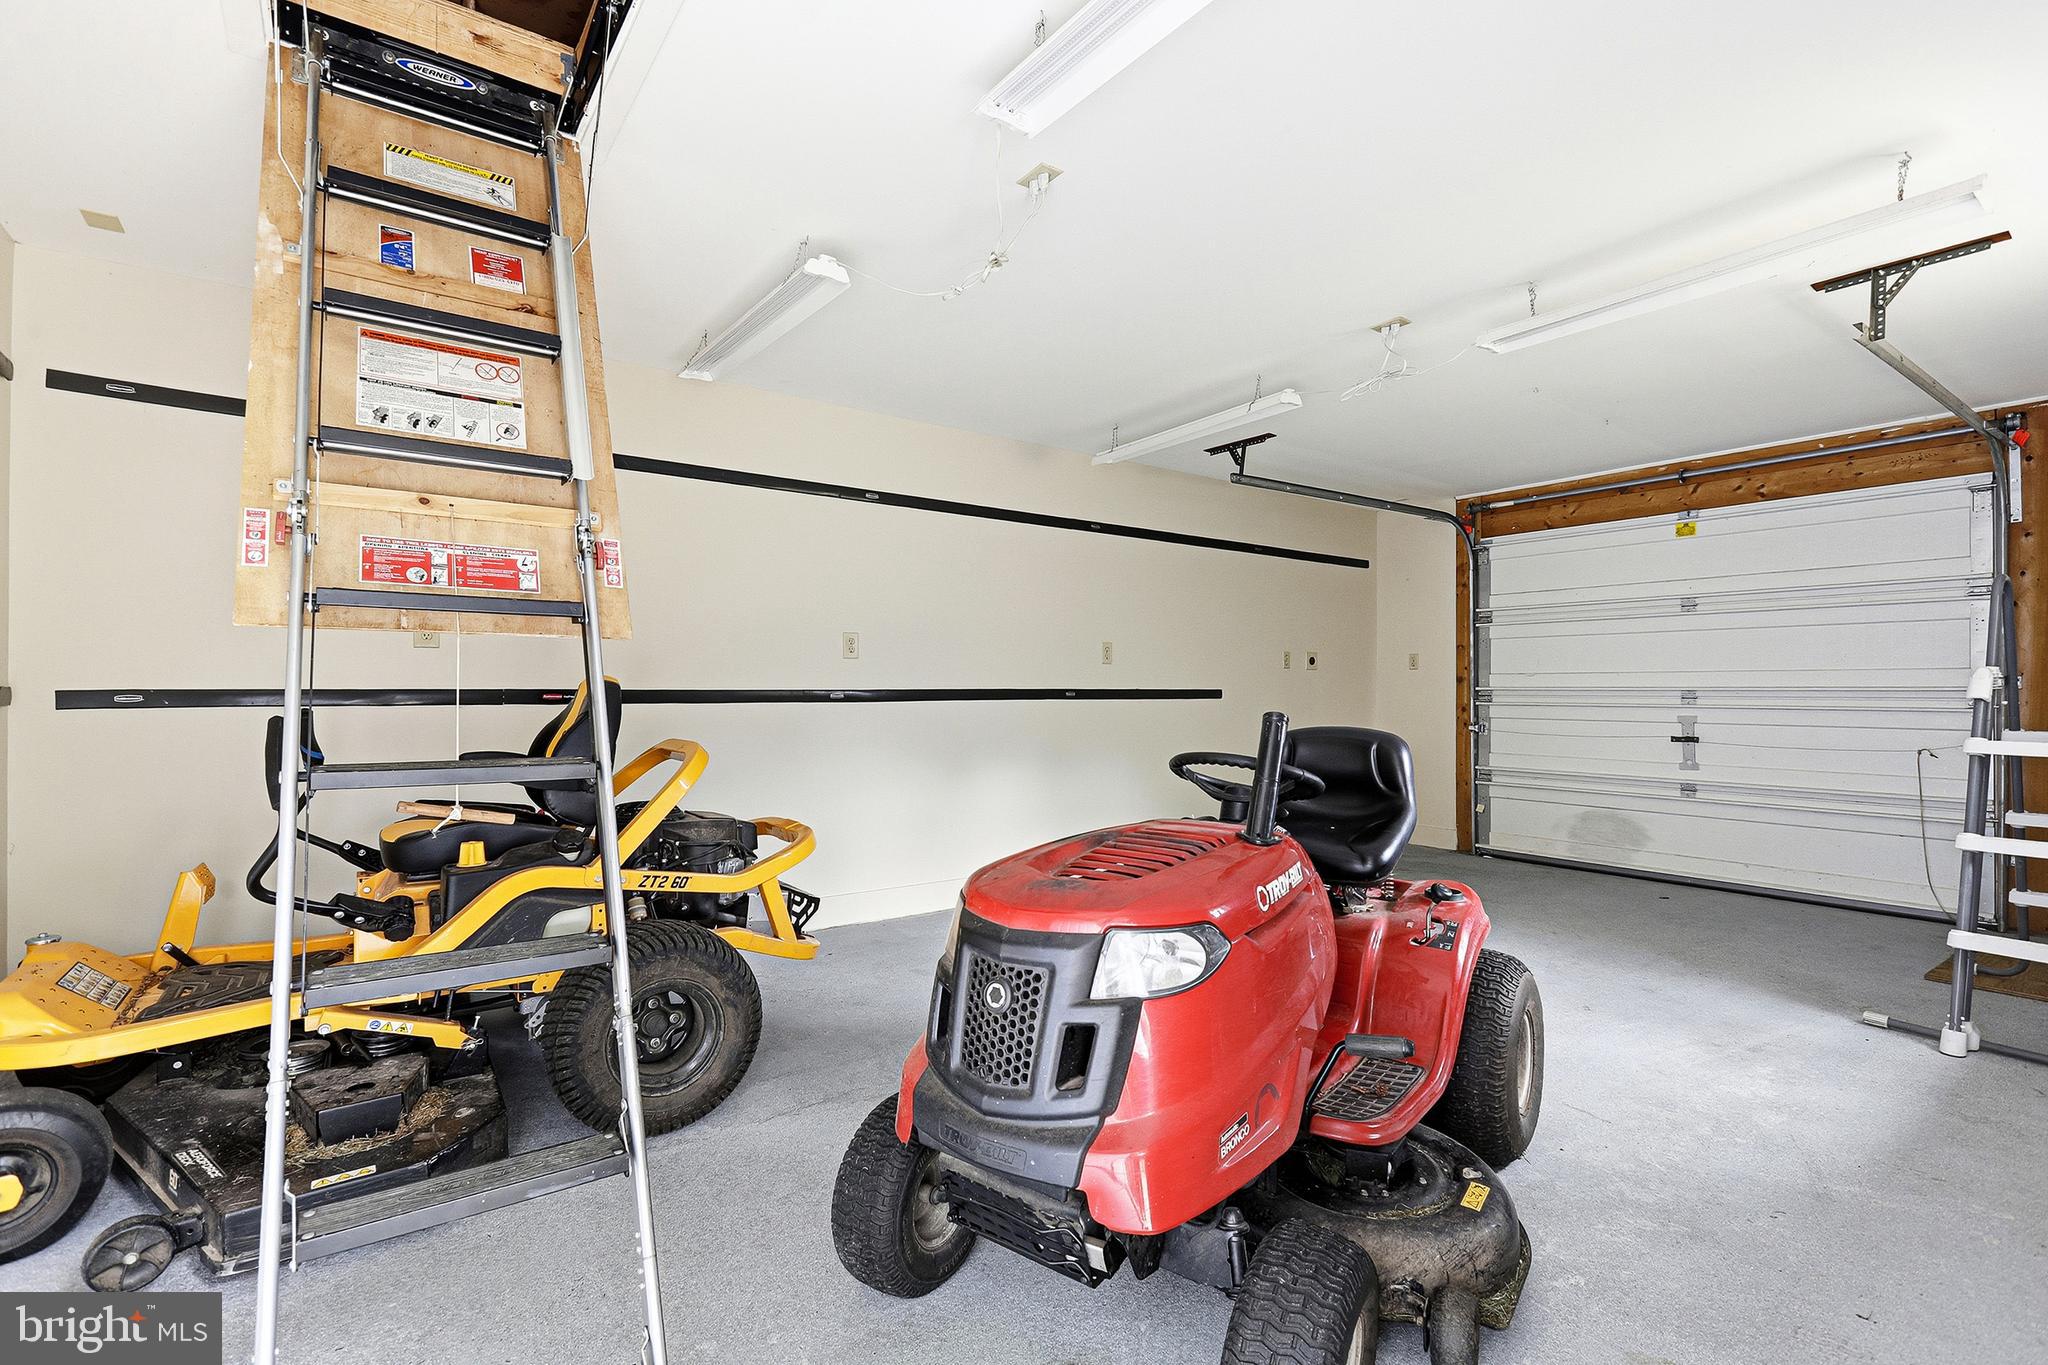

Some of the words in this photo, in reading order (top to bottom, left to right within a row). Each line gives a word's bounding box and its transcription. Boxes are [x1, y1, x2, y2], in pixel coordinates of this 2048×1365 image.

[413, 64, 458, 83] WERNER
[638, 875, 669, 888] ZT2
[671, 876, 689, 888] 60
[1221, 1123, 1250, 1159] BRONCO
[175, 1151, 196, 1167] DECK
